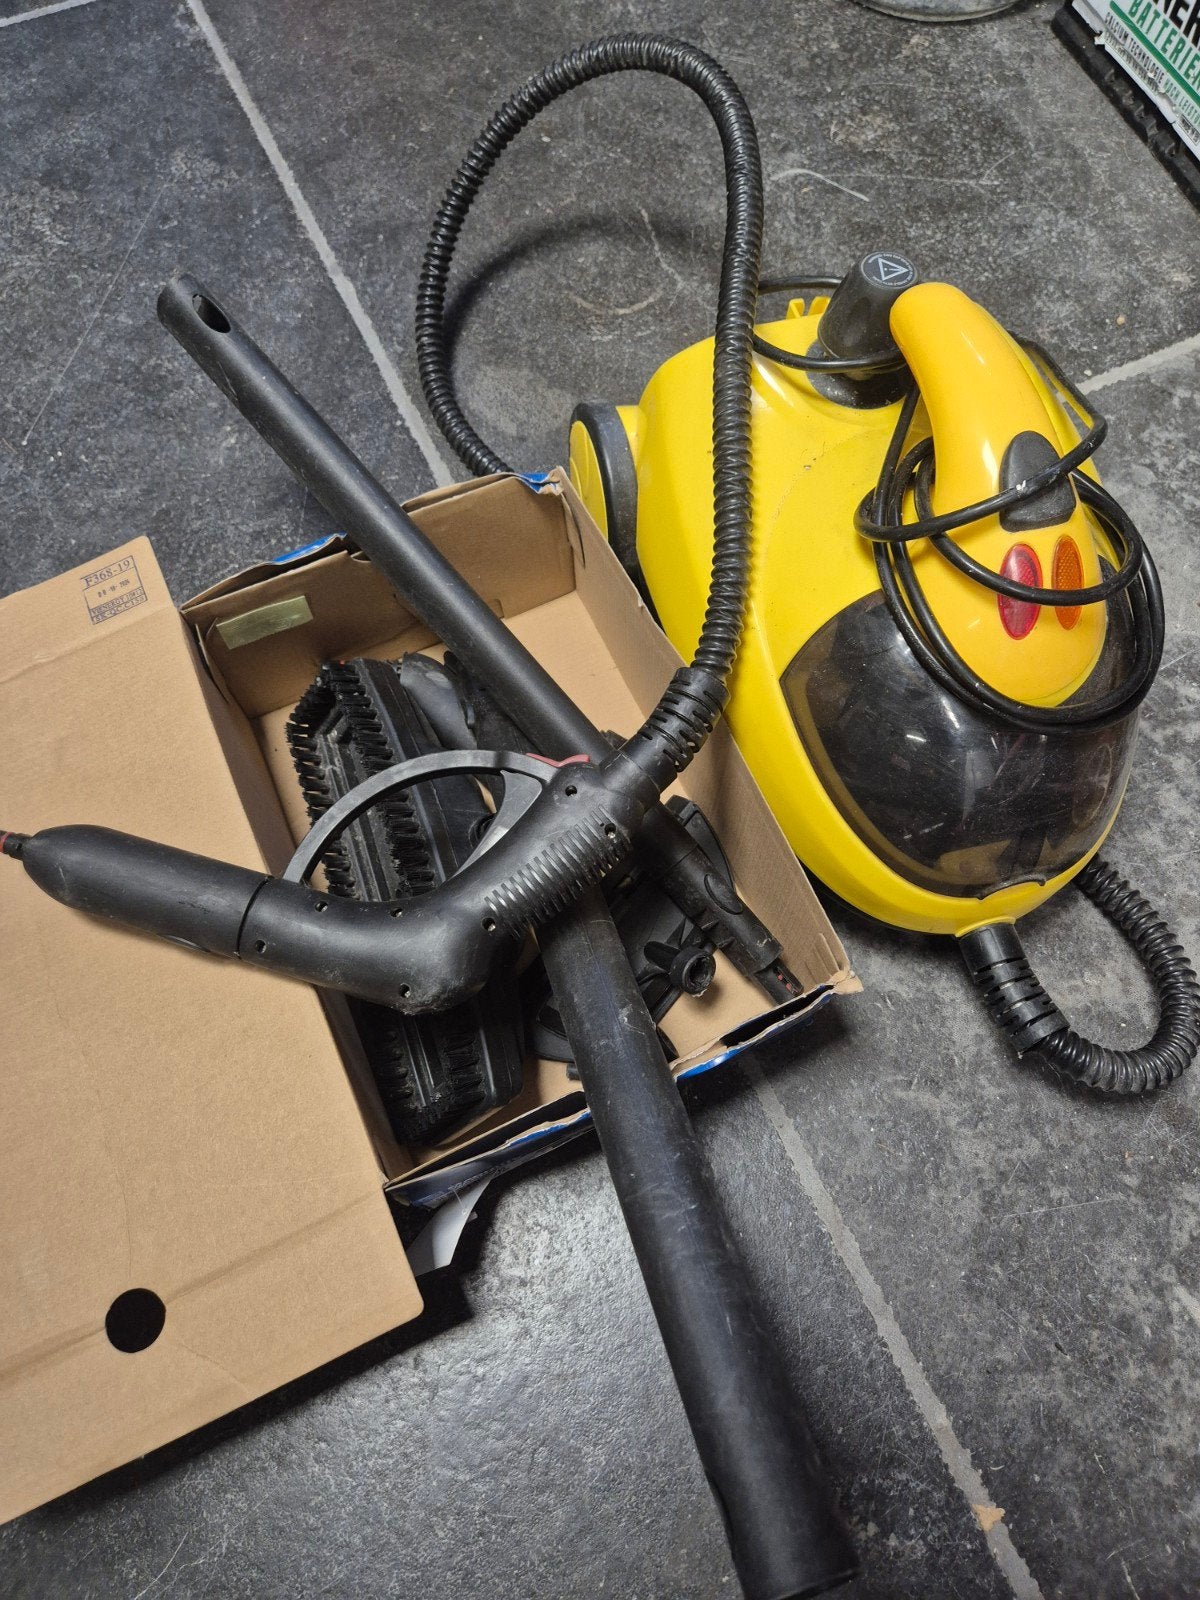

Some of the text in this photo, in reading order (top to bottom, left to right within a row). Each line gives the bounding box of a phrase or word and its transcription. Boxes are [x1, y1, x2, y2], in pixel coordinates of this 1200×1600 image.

[1105, 11, 1129, 44] CALCIUM
[1129, 37, 1165, 84] TECHNOLOGIE
[84, 559, 130, 587] F368-19
